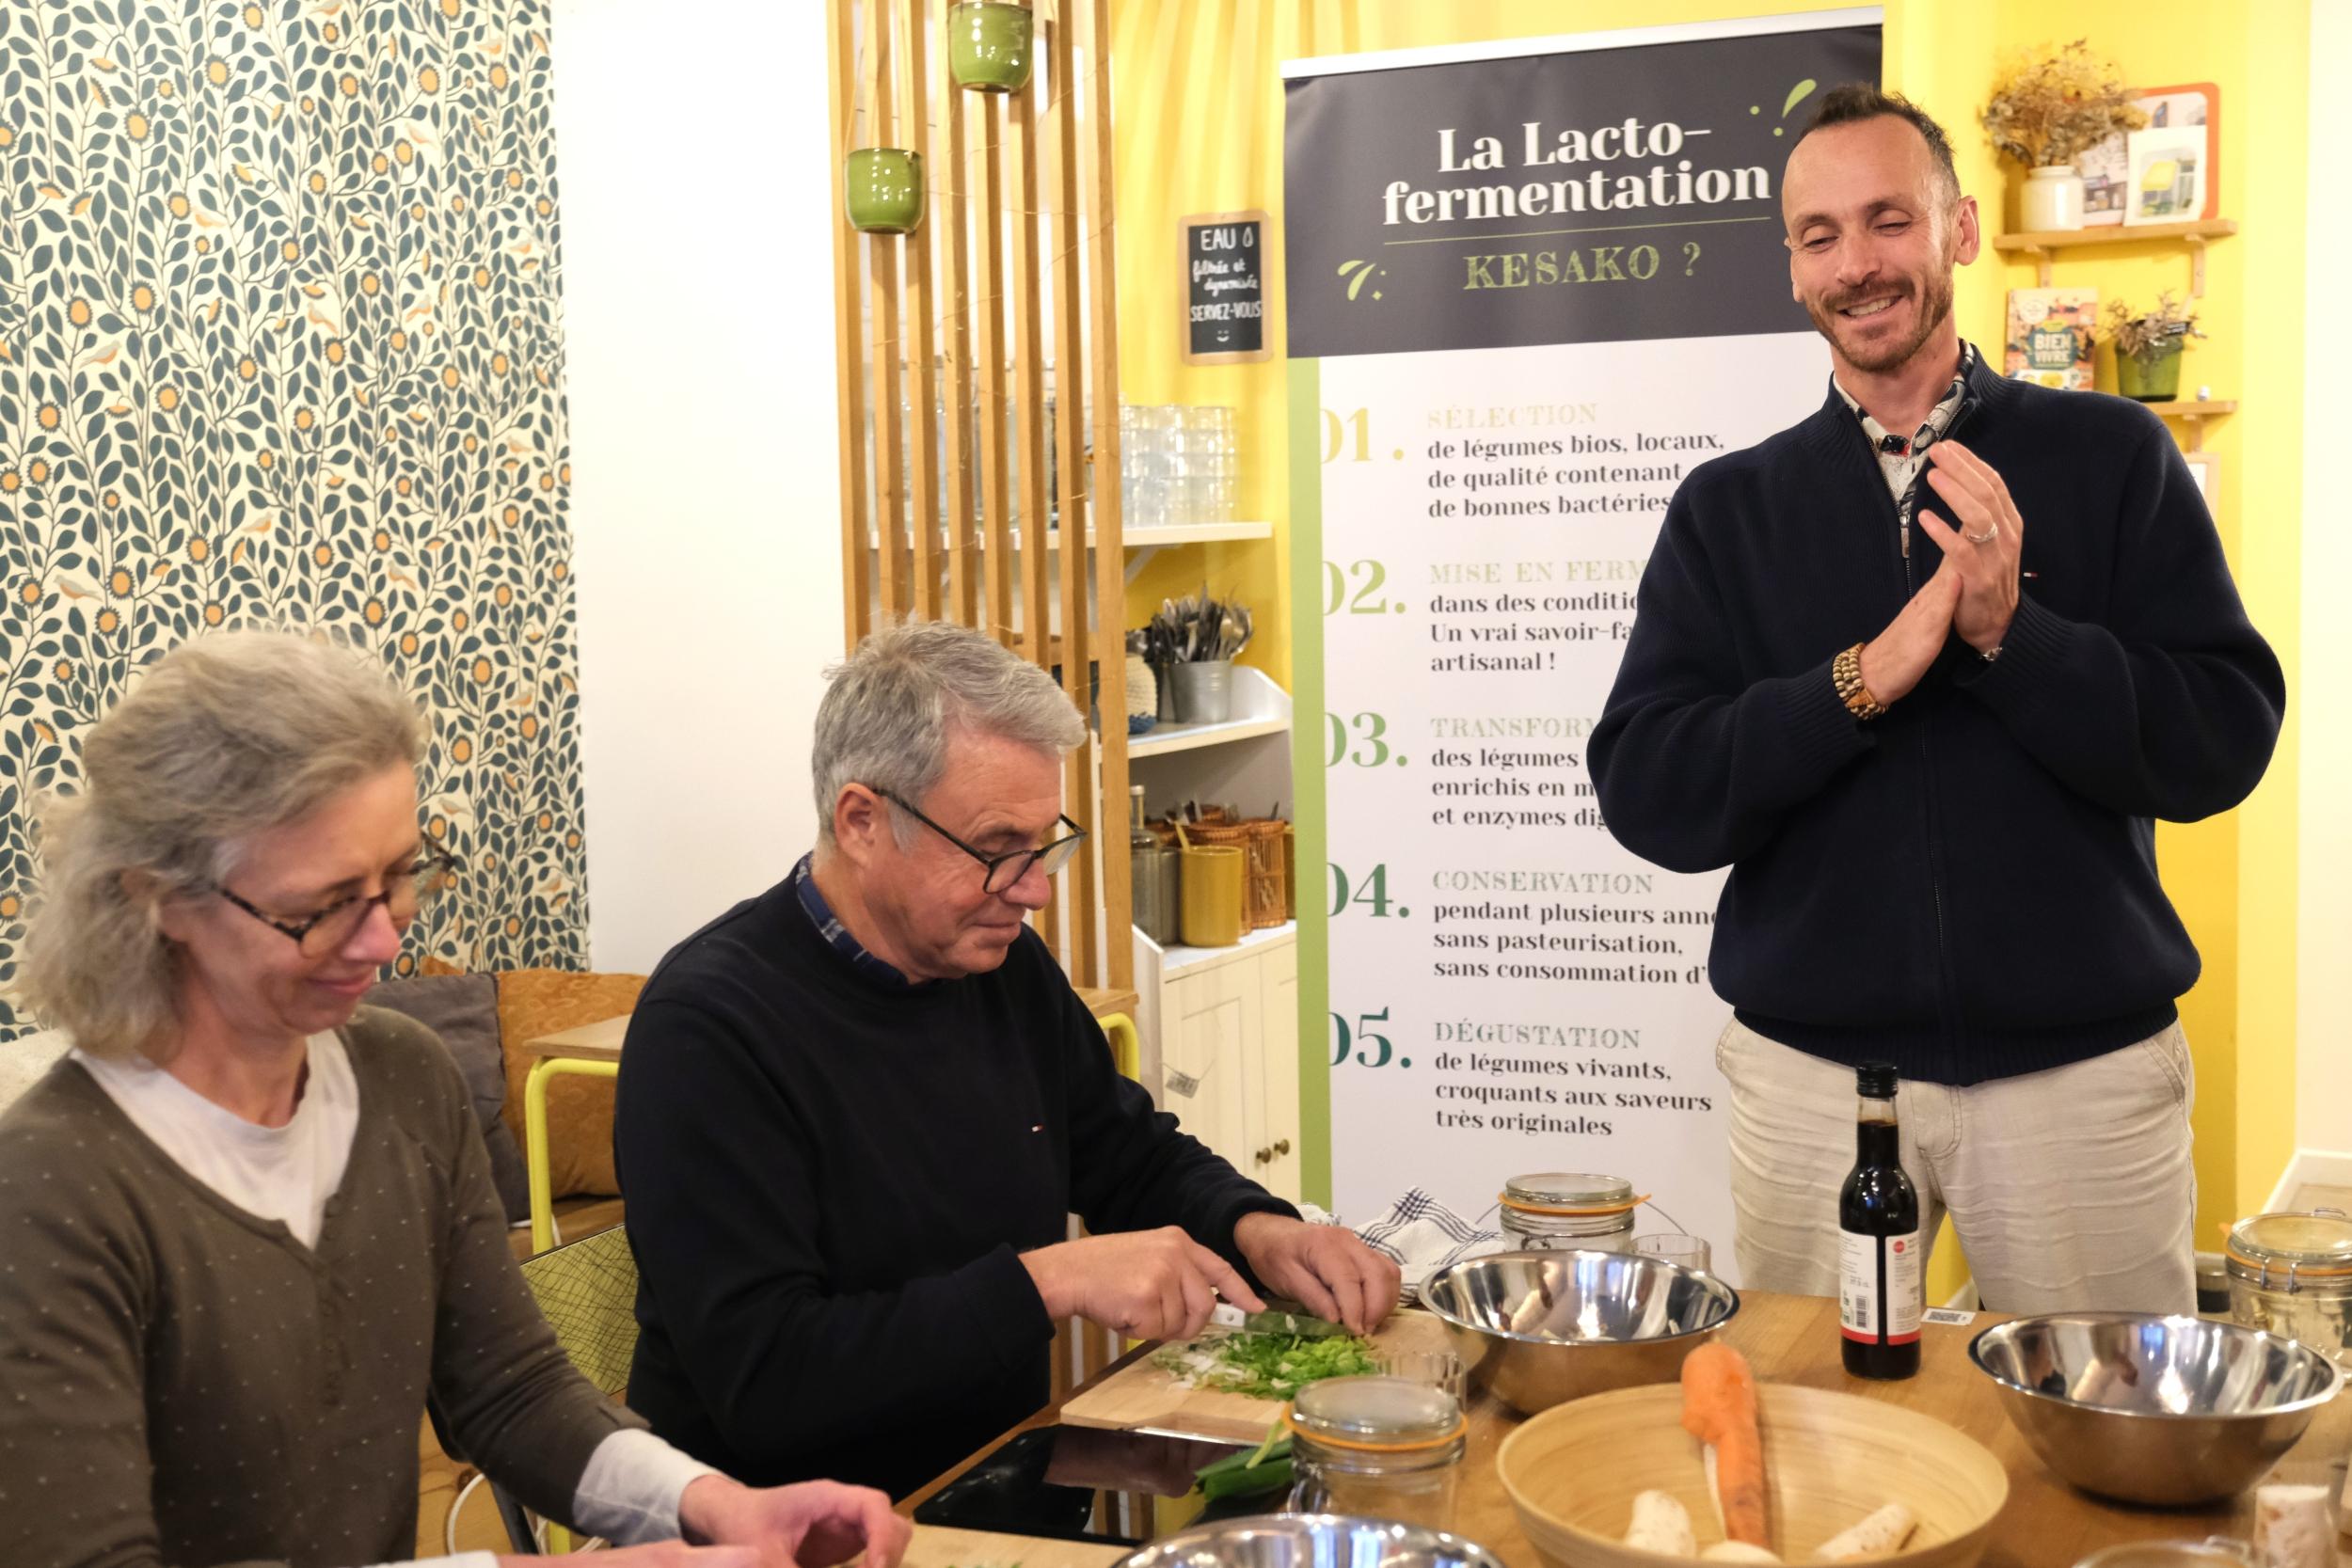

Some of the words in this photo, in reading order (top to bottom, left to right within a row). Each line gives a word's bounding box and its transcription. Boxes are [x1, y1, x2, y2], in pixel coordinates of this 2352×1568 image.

[1437, 128, 1505, 173] La
[1522, 118, 1711, 167] Lacto-
[1382, 160, 1772, 226] fermentation
[1200, 228, 1236, 251] EAU
[1462, 245, 1660, 291] KESAKO
[1682, 241, 1701, 277] ?
[1190, 300, 1262, 322] SERVEZ-VOUS
[2034, 332, 2072, 350] BIEN
[1428, 402, 1598, 430] SÉLECTION
[1427, 440, 1455, 459] de
[1464, 439, 1564, 462] légumes
[1571, 435, 1628, 454] bios,
[1637, 432, 1724, 451] locaux,
[1428, 469, 1456, 488] de
[1463, 467, 1549, 492] qualité
[1555, 463, 1683, 484] contenant
[1428, 499, 1456, 518] de
[1464, 498, 1550, 516] bonnes
[1558, 493, 1671, 514] bactéries
[1430, 562, 1502, 584] MISE
[1516, 562, 1553, 583] EN
[1566, 560, 1646, 581] FERM
[1430, 594, 1488, 613] dans
[1496, 594, 1535, 611] des
[1431, 624, 1462, 642] Un
[1470, 623, 1517, 641] vrai
[1525, 621, 1631, 641] savoir-fa
[1430, 717, 1597, 738] TRANSFOR
[1431, 748, 1472, 767] des
[1480, 748, 1579, 771] légumes
[1432, 777, 1531, 796] enrichis
[1537, 782, 1565, 797] en
[1432, 808, 1453, 825] et
[1463, 811, 1566, 830] enzymes
[1432, 870, 1653, 895] CONSERVATION
[1434, 901, 1531, 924] pendant
[1540, 903, 1655, 926] plusieurs
[1434, 934, 1489, 949] sans
[1497, 933, 1683, 955] pasteurisation,
[1434, 962, 1489, 977] sans
[1497, 964, 1677, 984] consommation
[1435, 1018, 1641, 1050] DÉGUSTATION
[1435, 1052, 1463, 1069] de
[1470, 1053, 1569, 1076] légumes
[1576, 1058, 1672, 1081] vivants,
[1435, 1085, 1557, 1105] croquants
[1565, 1091, 1607, 1106] aux
[1615, 1093, 1712, 1112] saveurs
[1436, 1110, 1484, 1129] très
[1490, 1112, 1613, 1136] originales
